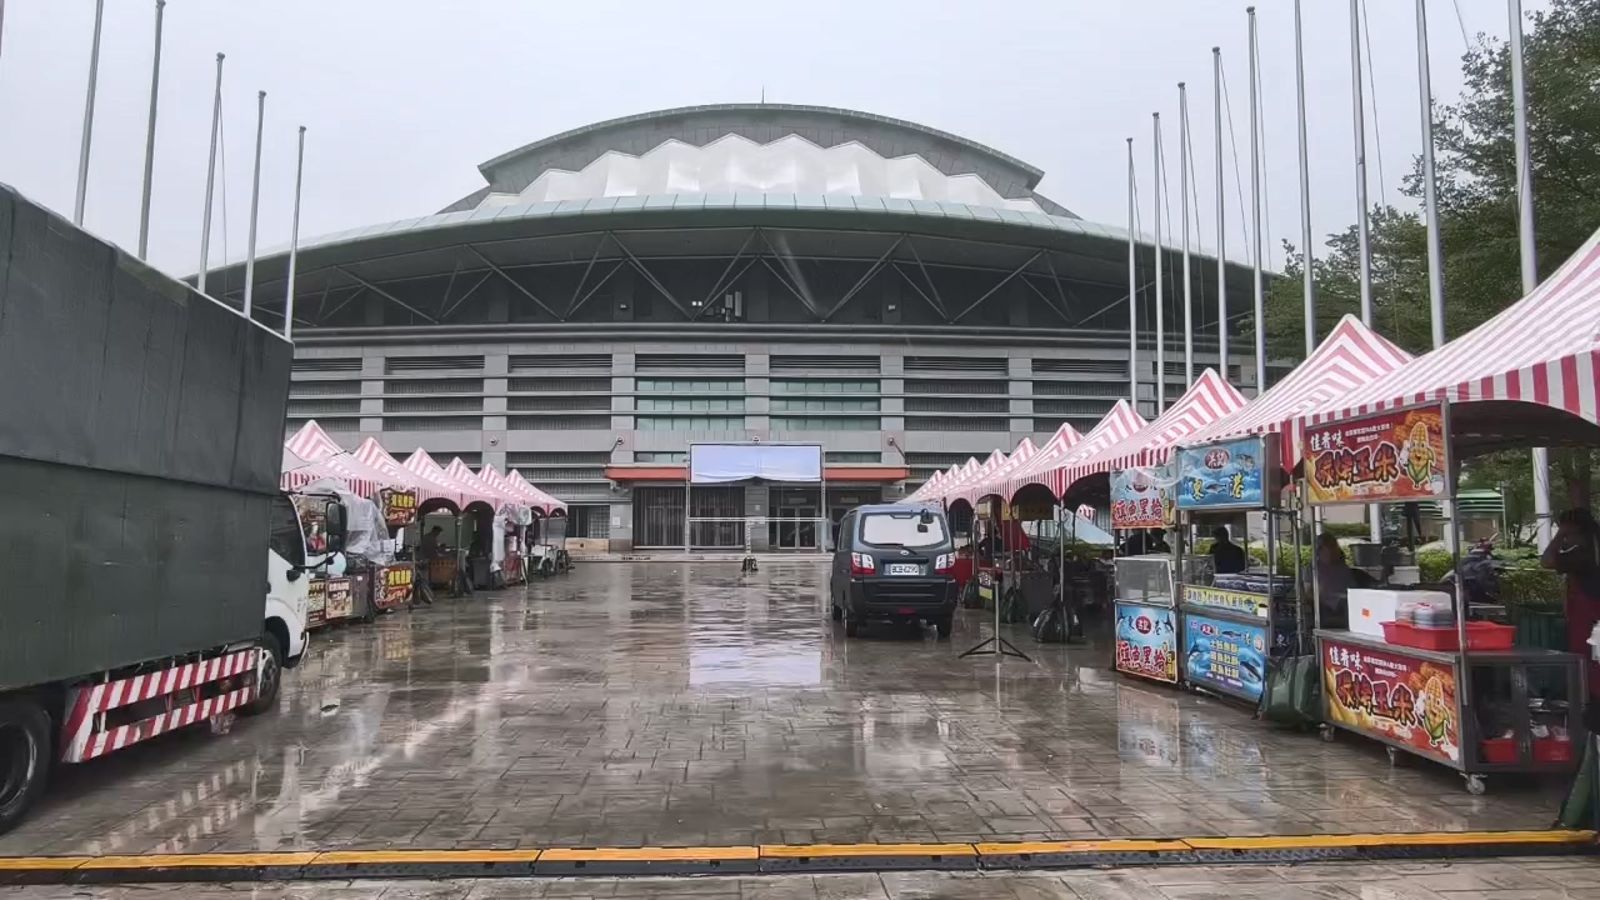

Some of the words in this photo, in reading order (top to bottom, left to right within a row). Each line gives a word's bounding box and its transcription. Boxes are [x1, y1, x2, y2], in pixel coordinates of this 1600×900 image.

[1310, 429, 1345, 451] 佳香味
[1329, 646, 1363, 672] 佳香味
